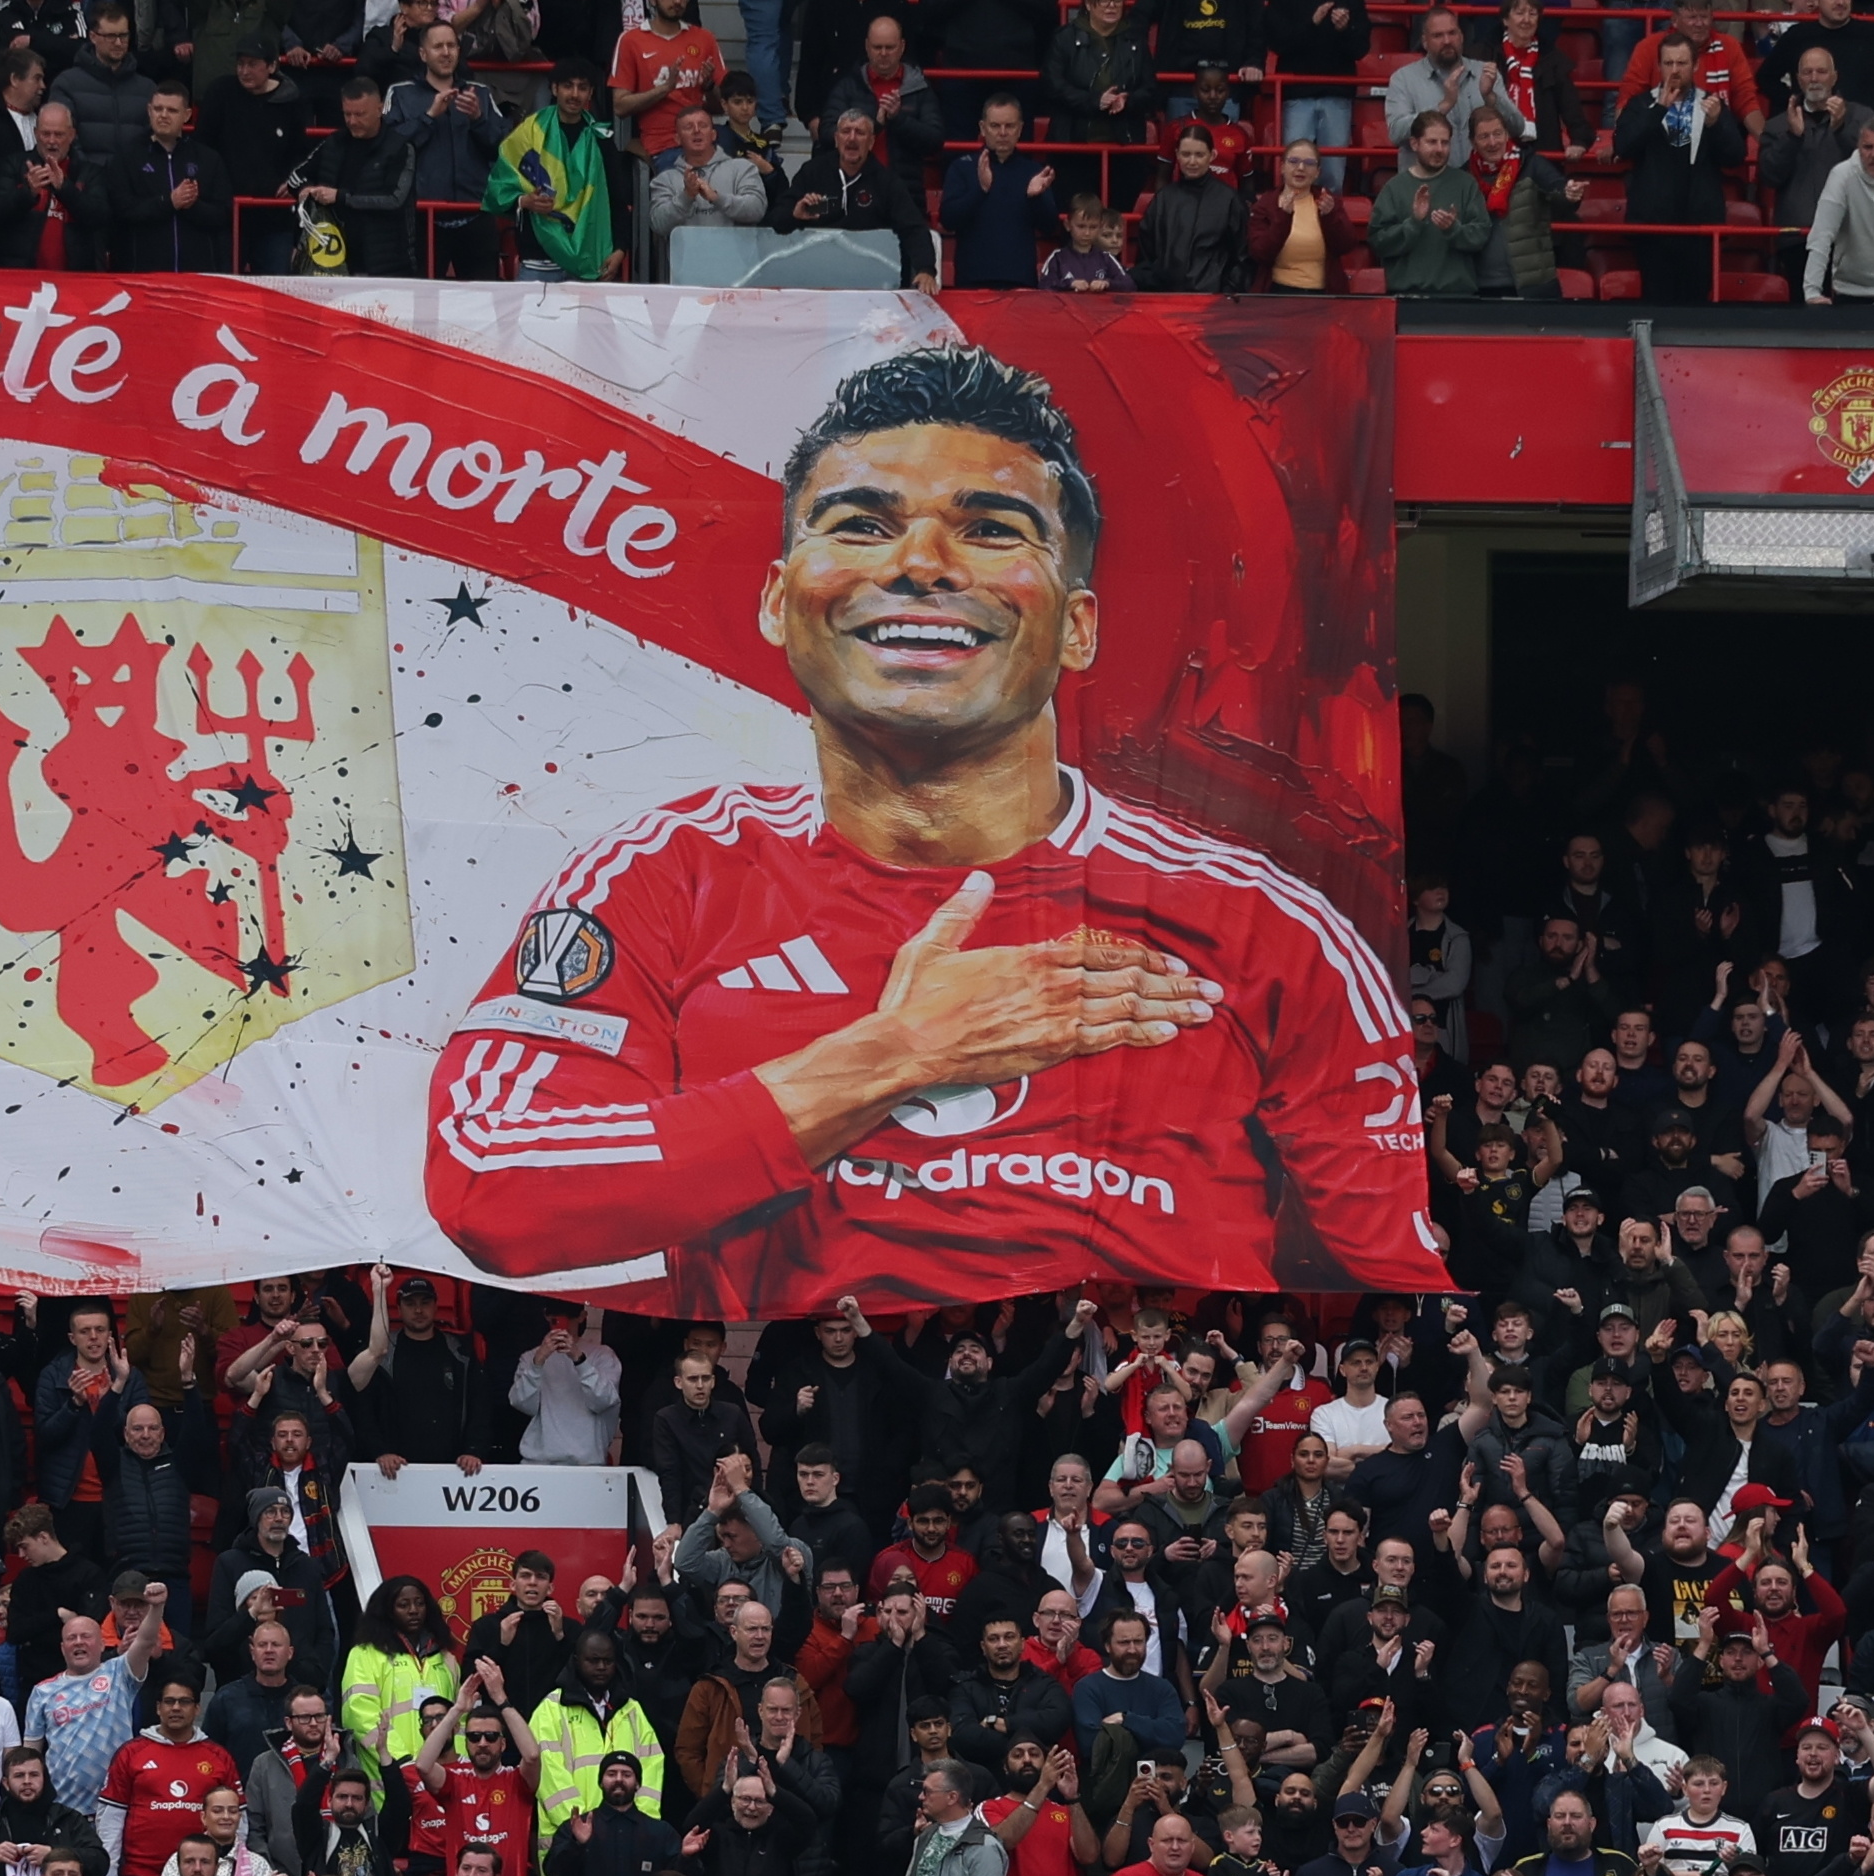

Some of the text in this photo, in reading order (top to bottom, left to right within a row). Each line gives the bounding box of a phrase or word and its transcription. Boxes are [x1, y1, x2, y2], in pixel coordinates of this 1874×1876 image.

[171, 325, 266, 448] à
[298, 390, 677, 581] morte
[1354, 1053, 1425, 1128] DX
[442, 1486, 540, 1513] W206
[449, 1551, 515, 1590] MANCHES
[1784, 1830, 1825, 1850] AIG
